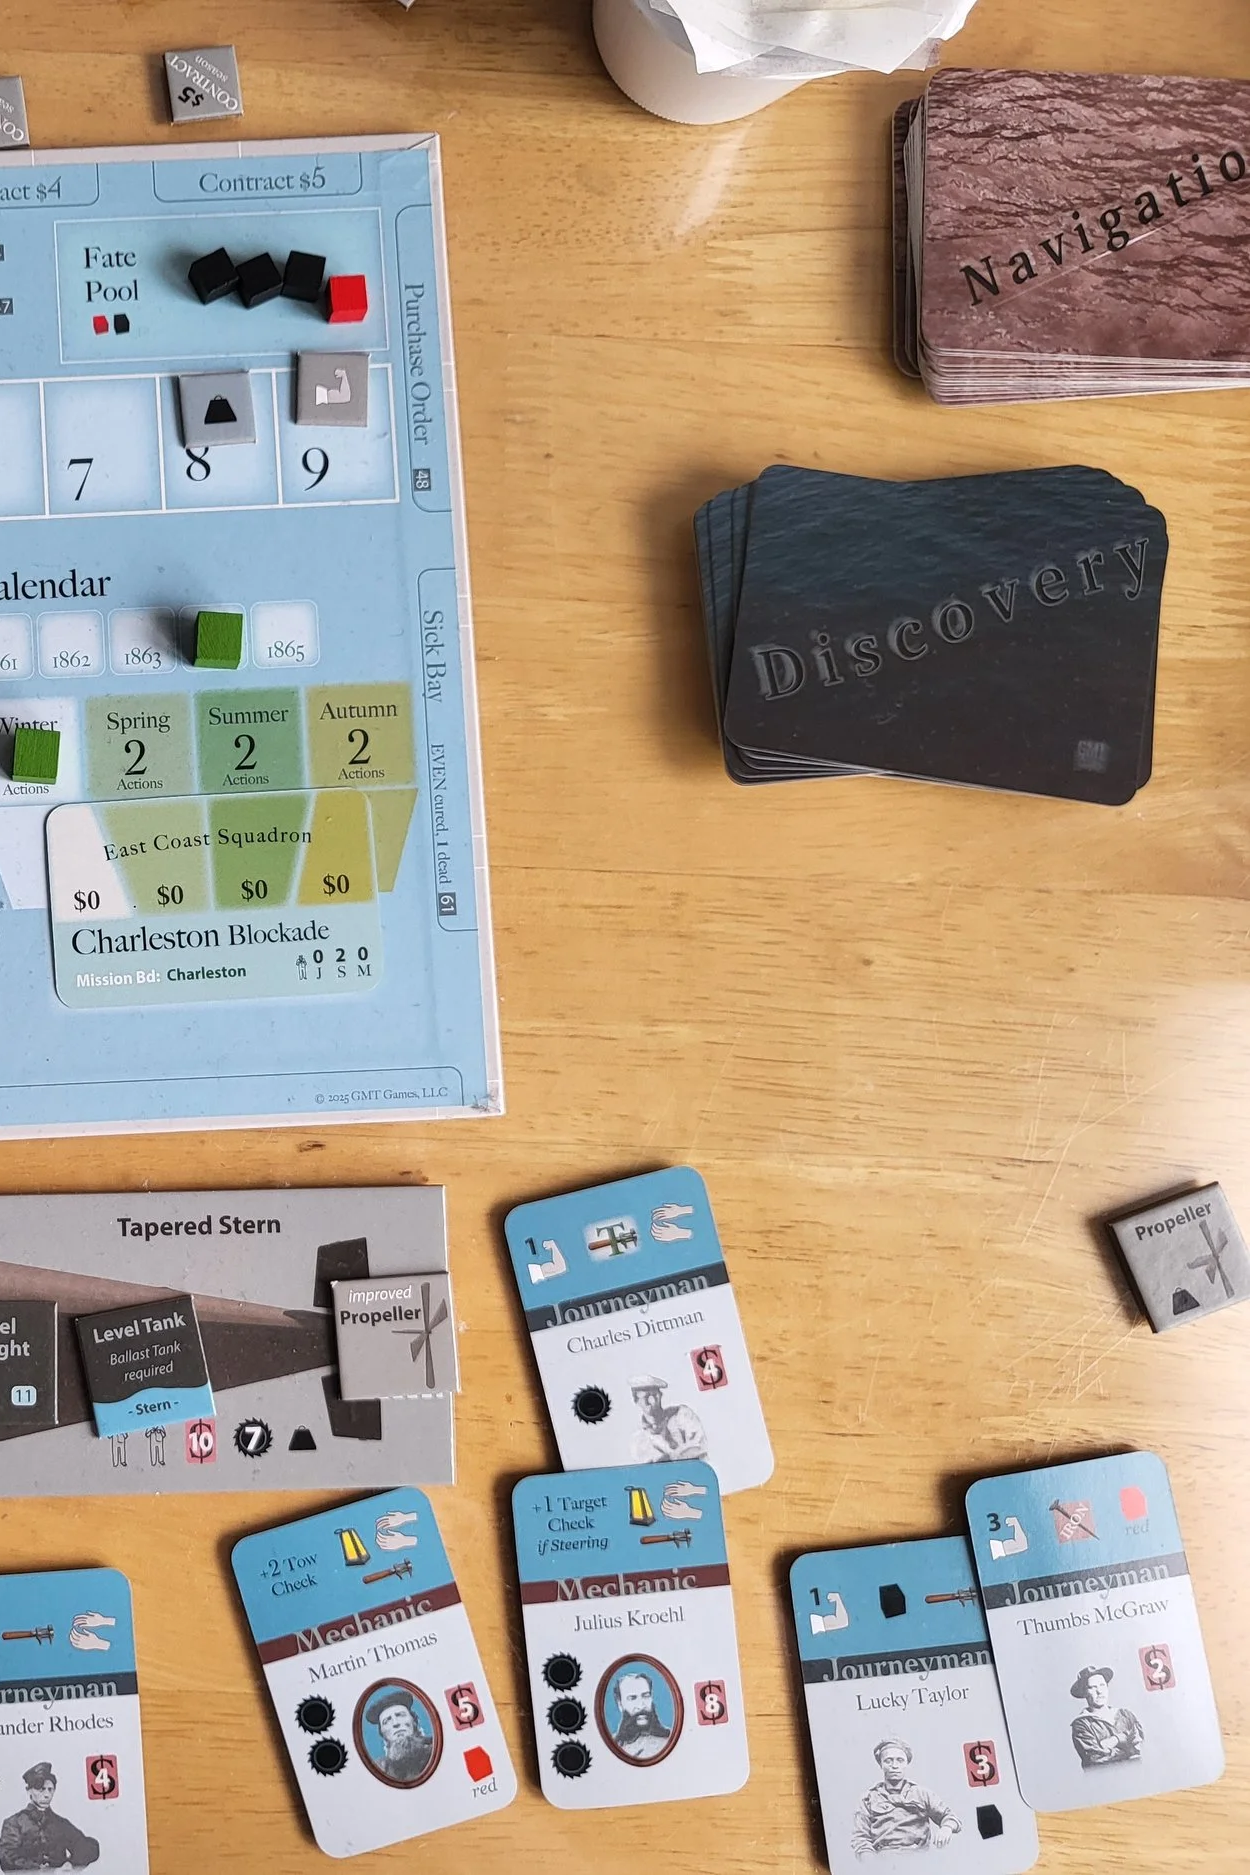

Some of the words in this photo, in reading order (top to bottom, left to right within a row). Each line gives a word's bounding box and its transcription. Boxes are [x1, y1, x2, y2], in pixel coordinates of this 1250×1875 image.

[170, 55, 238, 111] CONTRACT
[178, 87, 204, 106] $5
[199, 172, 294, 194] Contract
[300, 167, 325, 192] $5
[960, 148, 1246, 305] Navigatio
[84, 246, 137, 268] Fate
[86, 280, 138, 302] Pool
[405, 282, 426, 378] Purchase
[412, 381, 432, 445] Order
[301, 447, 330, 491] 9
[758, 536, 1150, 701] Discovery
[267, 641, 305, 661] 1865
[106, 712, 170, 733] Spring
[208, 708, 288, 726] Summer
[320, 702, 398, 720] Autumn
[104, 843, 147, 861] East
[153, 833, 210, 851] Coast
[218, 829, 312, 846] Squadron
[71, 929, 219, 956] Charleston
[229, 922, 329, 946] Blockade
[76, 971, 132, 987] Mission
[136, 970, 161, 983] Bd:
[167, 964, 247, 982] Charleston
[328, 1092, 349, 1103] 2025
[351, 1090, 381, 1102] GMT
[384, 1089, 419, 1100] Games,
[422, 1087, 448, 1098] LLC
[118, 1216, 212, 1239] Tapered
[219, 1215, 281, 1235] Stern
[1135, 1202, 1212, 1240] Propeller
[349, 1285, 412, 1305] improved
[93, 1320, 139, 1343] Level
[141, 1313, 186, 1334] Tank
[340, 1306, 422, 1328] Propeller
[566, 1324, 631, 1356] Charles
[636, 1310, 705, 1342] Dittman
[1061, 1503, 1090, 1540] IRON
[294, 1595, 434, 1655] Mechanic
[574, 1609, 621, 1633] Julius
[627, 1606, 684, 1627] Kroehl
[1017, 1613, 1090, 1637] Thumbs
[1094, 1600, 1169, 1624] McGraw
[308, 1655, 367, 1684] Martin
[369, 1630, 438, 1664] Thomas
[49, 1714, 114, 1732] Rhodes
